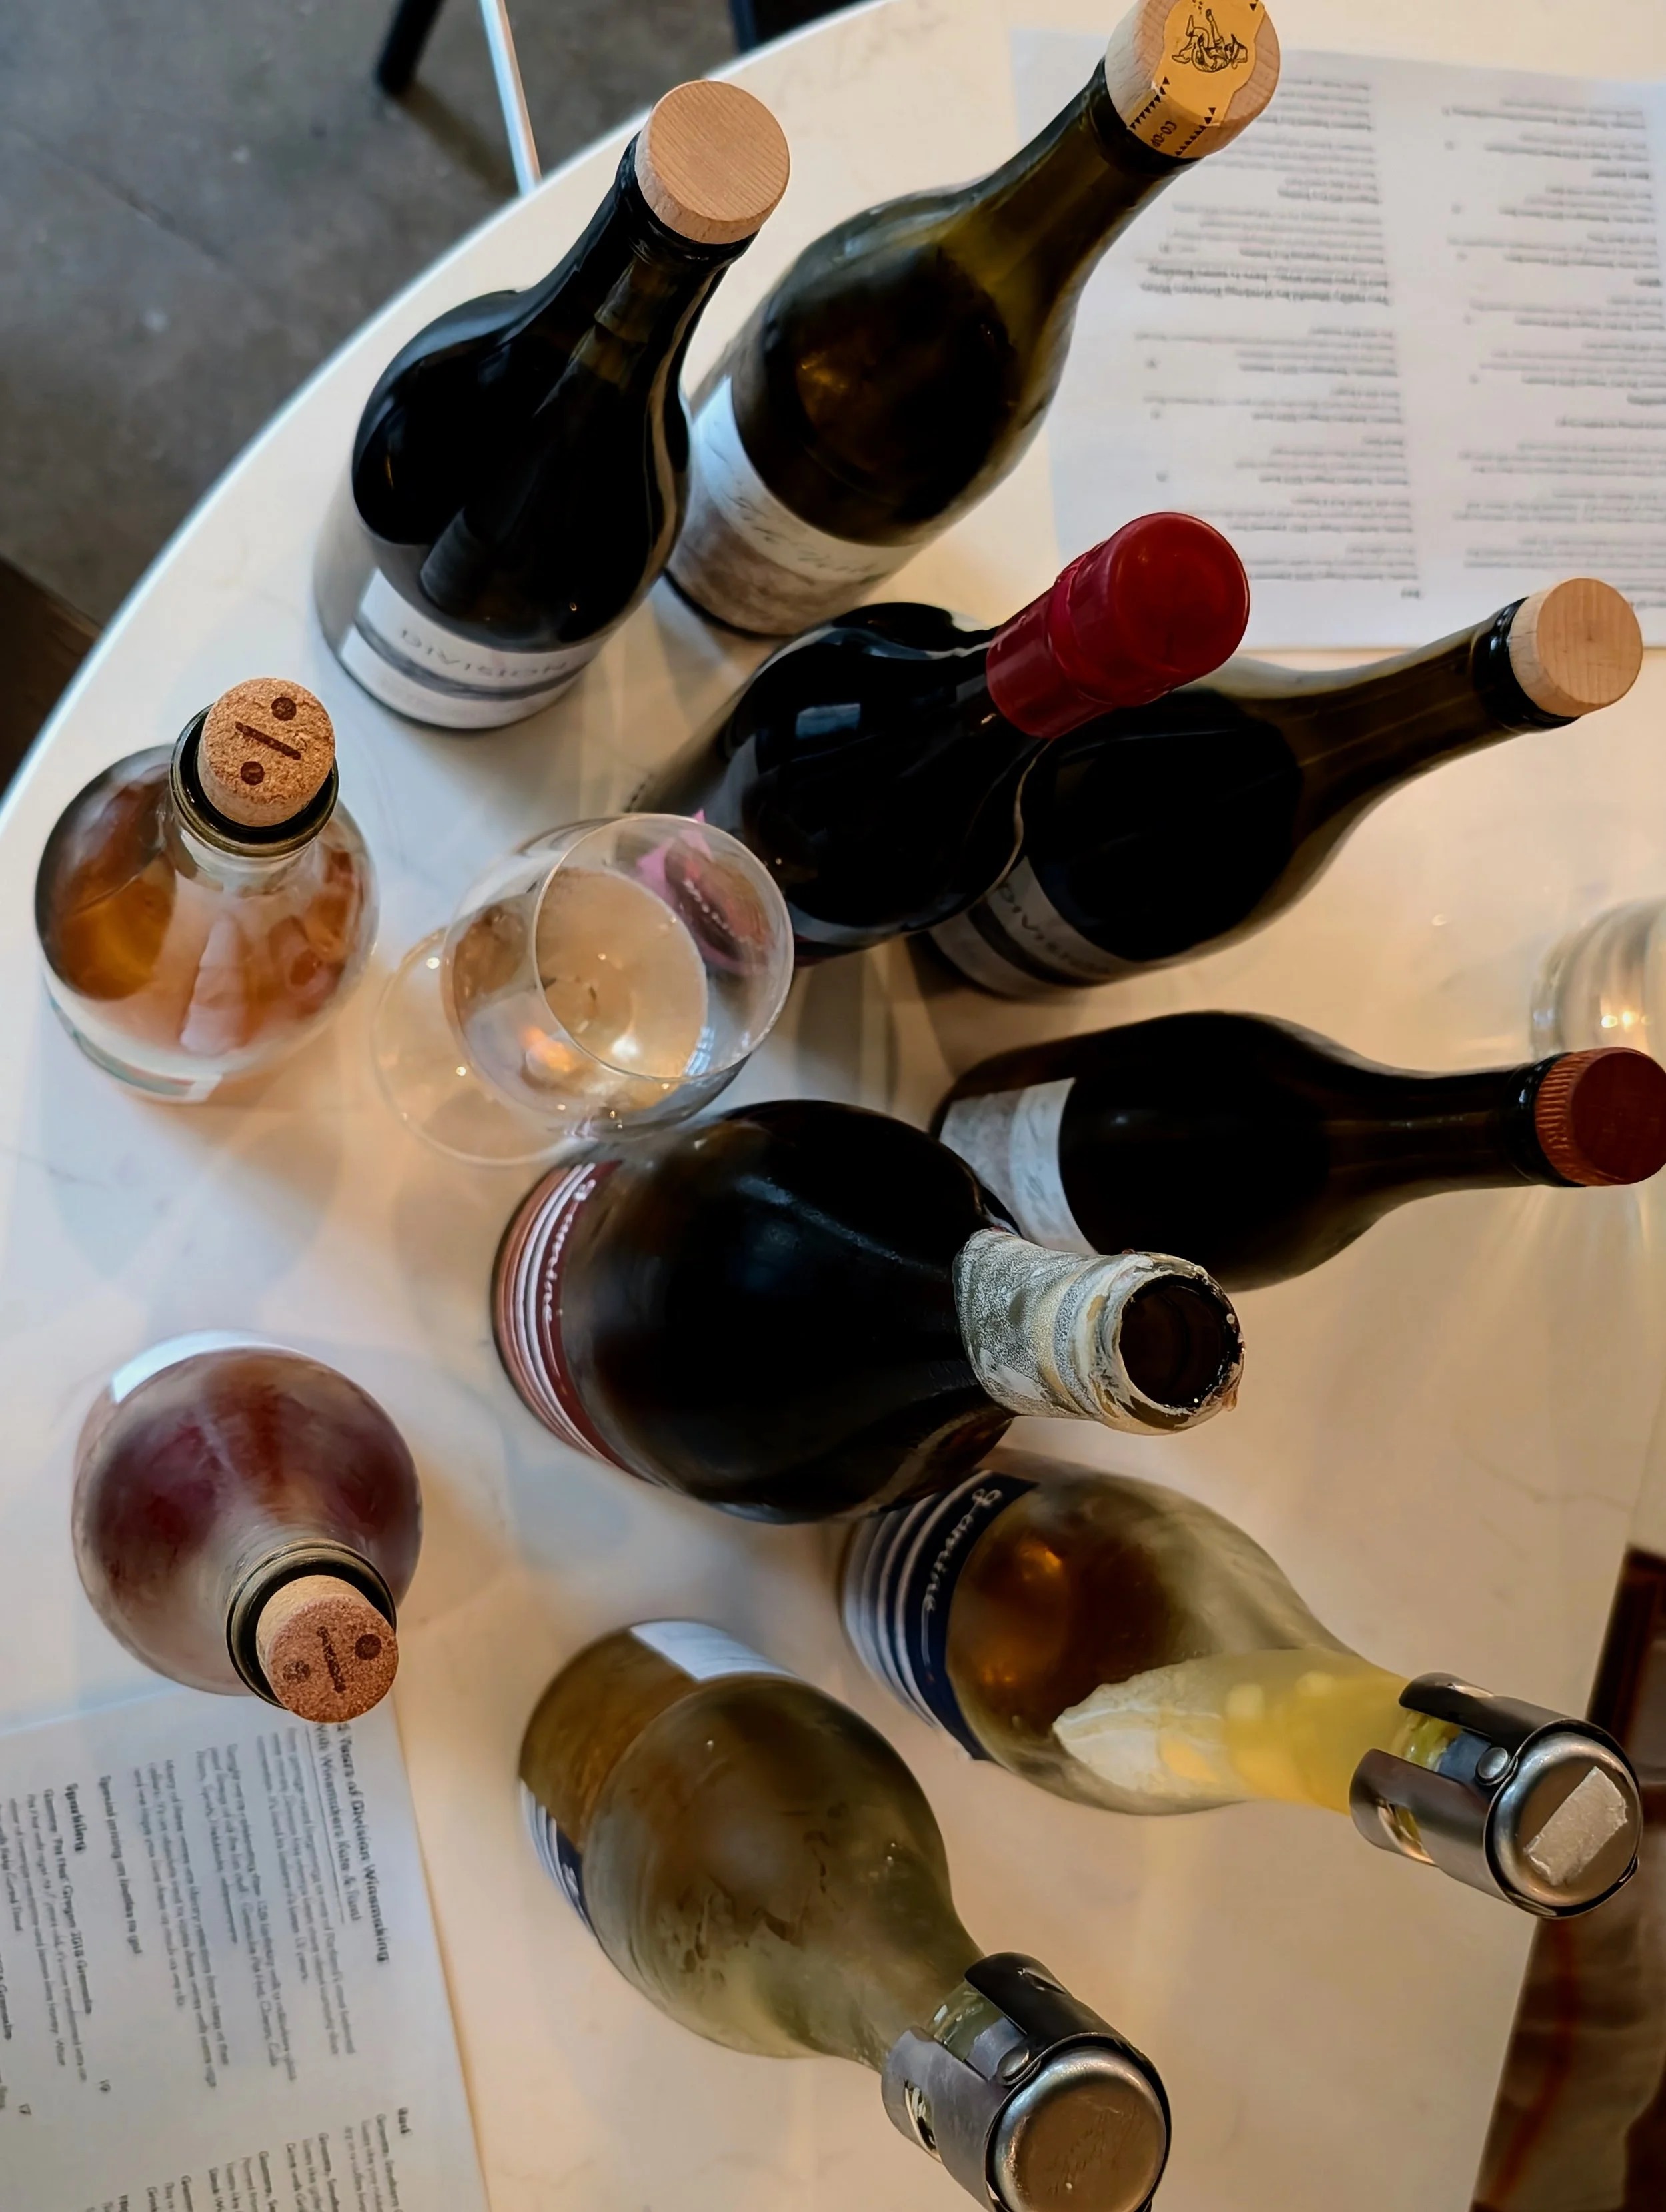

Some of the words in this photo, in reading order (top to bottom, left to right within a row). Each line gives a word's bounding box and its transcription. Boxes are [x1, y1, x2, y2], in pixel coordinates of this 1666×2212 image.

[1151, 121, 1177, 149] CO-OP
[400, 627, 567, 680] DIVISION
[65, 1783, 86, 1852] Sparkling
[320, 1753, 343, 1837] Winemakers
[347, 1780, 363, 1797] of
[350, 1799, 369, 1861] Division
[363, 1864, 389, 1963] Winemaking
